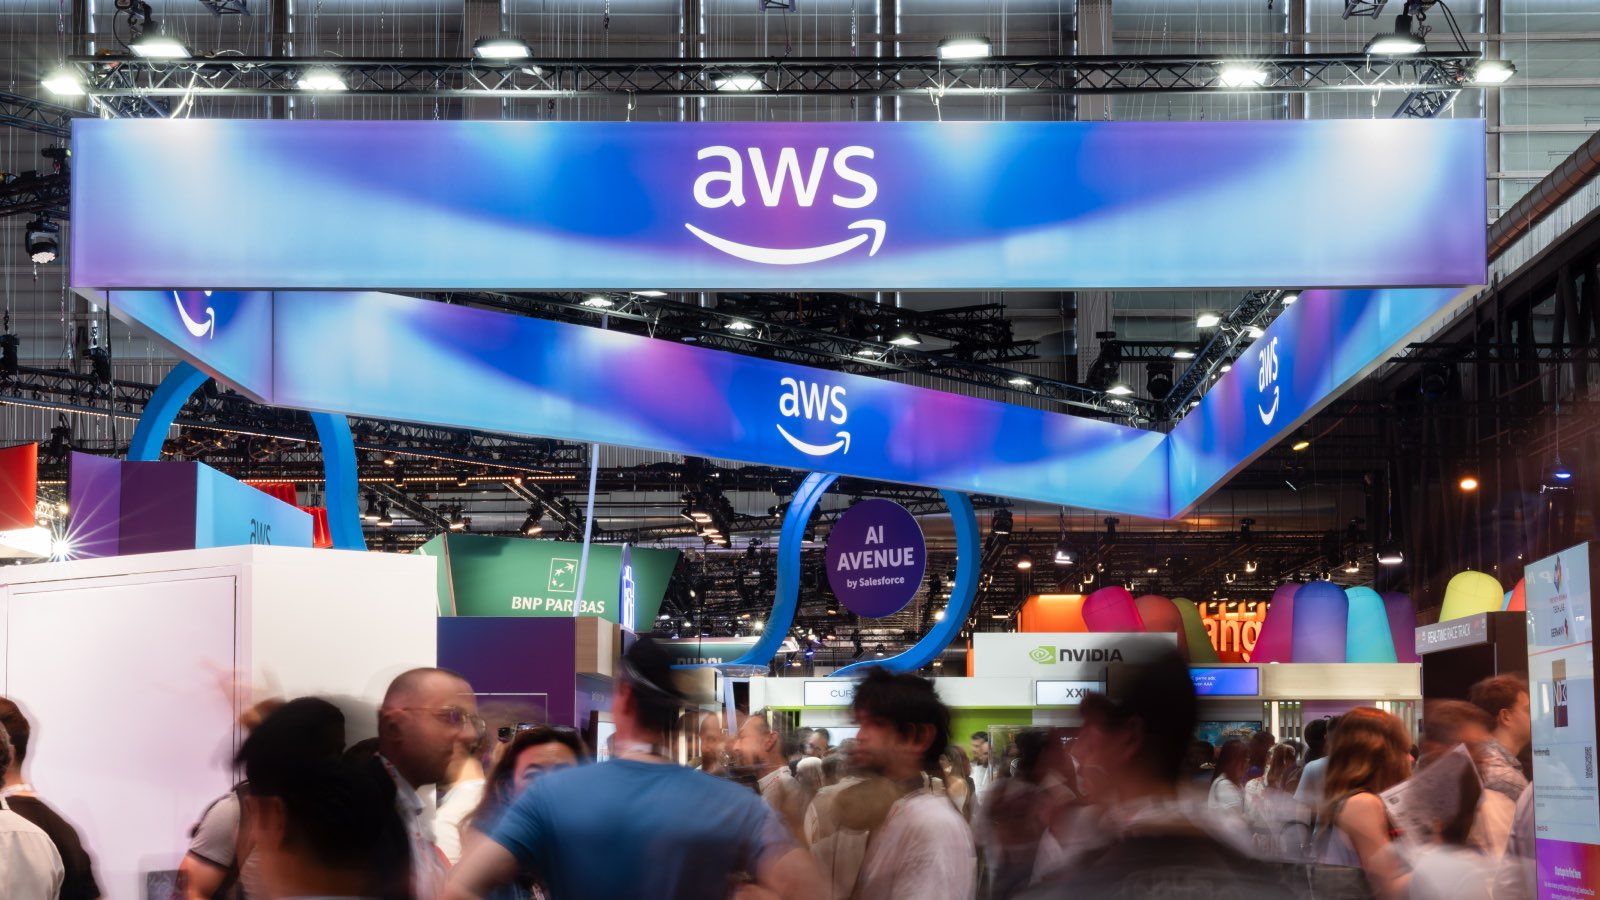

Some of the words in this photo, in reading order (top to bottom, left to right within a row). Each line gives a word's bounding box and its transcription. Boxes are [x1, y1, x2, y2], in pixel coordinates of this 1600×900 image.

[693, 145, 878, 209] aws
[1258, 336, 1278, 393] aws
[779, 377, 848, 425] aws
[250, 518, 271, 546] aws
[864, 525, 884, 544] AI
[837, 547, 915, 571] AVENUE
[847, 579, 857, 589] by
[859, 576, 905, 587] Salesforce
[511, 596, 543, 610] BNP
[1202, 618, 1263, 663] ang
[1446, 626, 1457, 640] RACE
[1458, 623, 1471, 637] TRACK
[1060, 649, 1123, 662] NVIDIA
[830, 690, 854, 698] CUR
